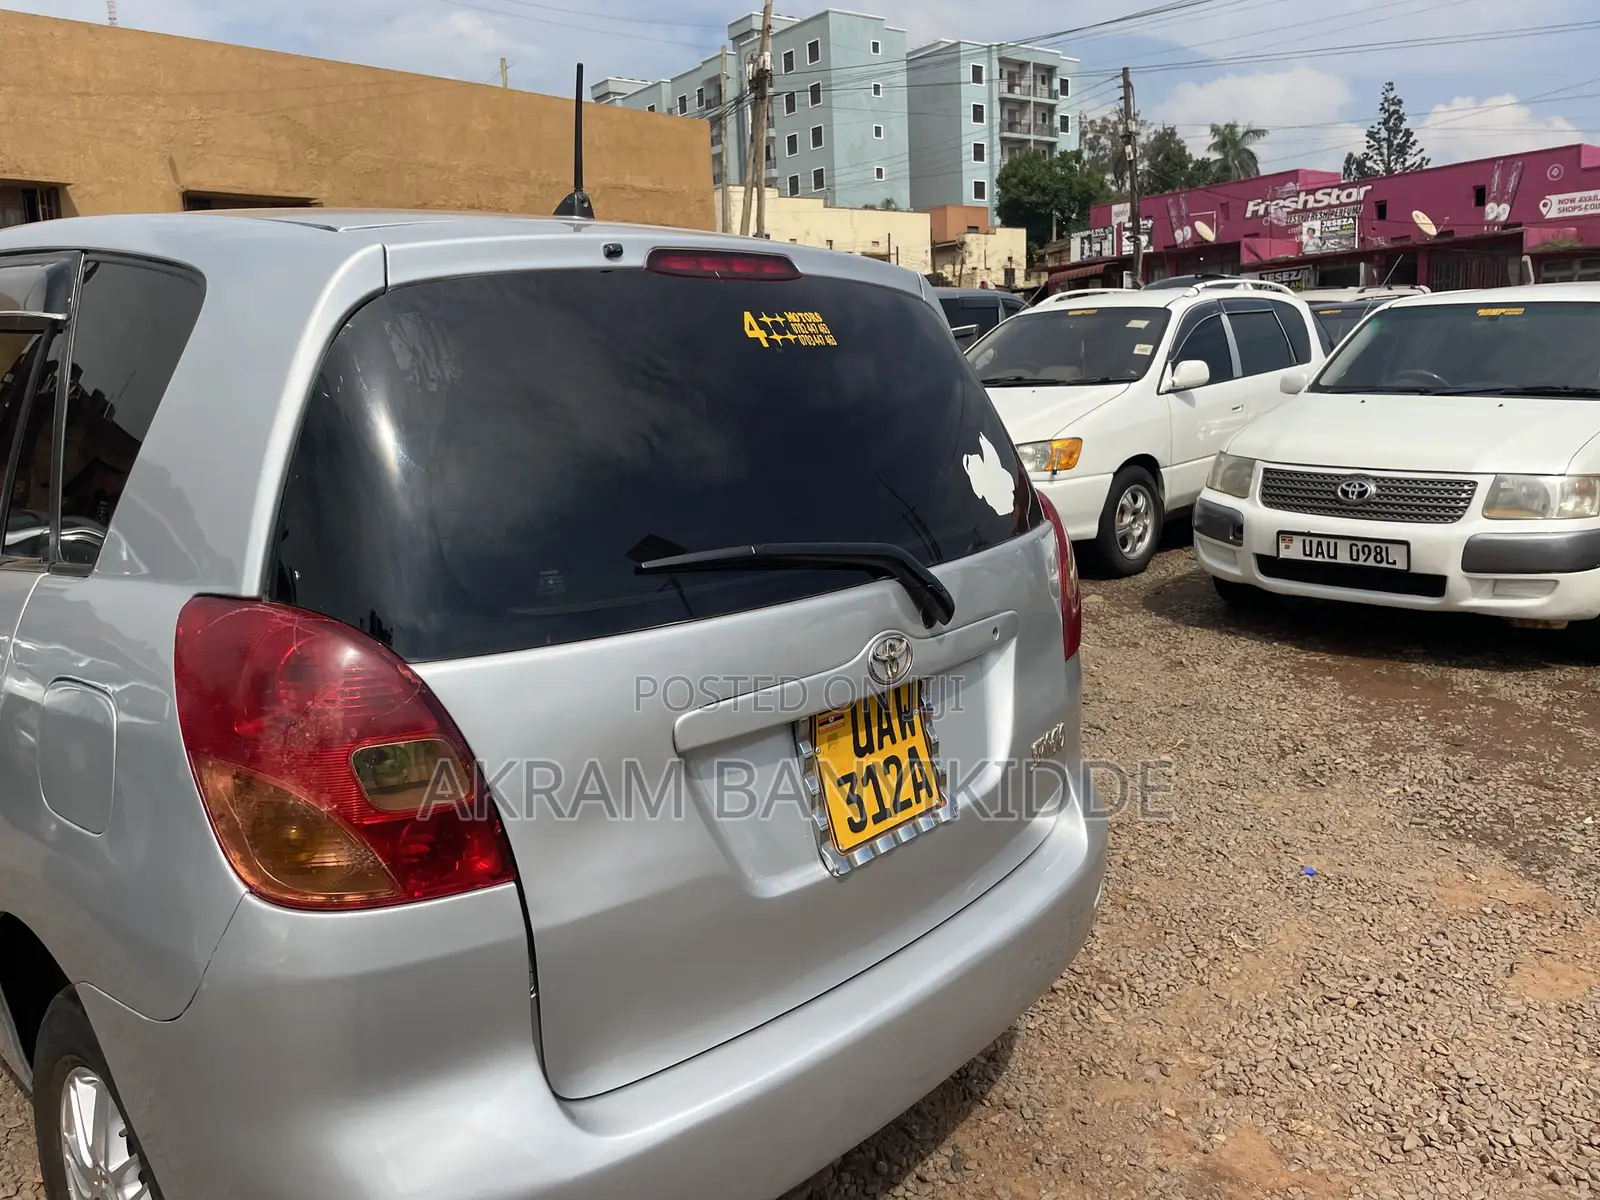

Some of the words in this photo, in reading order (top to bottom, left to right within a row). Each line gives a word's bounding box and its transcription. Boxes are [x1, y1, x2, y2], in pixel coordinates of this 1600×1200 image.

[1245, 184, 1373, 218] FreshStar
[1557, 204, 1583, 213] SHOPS
[1558, 197, 1577, 205] NOW
[1306, 209, 1329, 221] FRESH
[1321, 217, 1354, 227] JESEZA
[783, 311, 823, 323] MOTORS
[743, 311, 770, 348] 4
[1302, 538, 1338, 560] UAU
[1349, 542, 1397, 566] 098L
[850, 679, 916, 759] UAW
[836, 745, 934, 834] 312A
